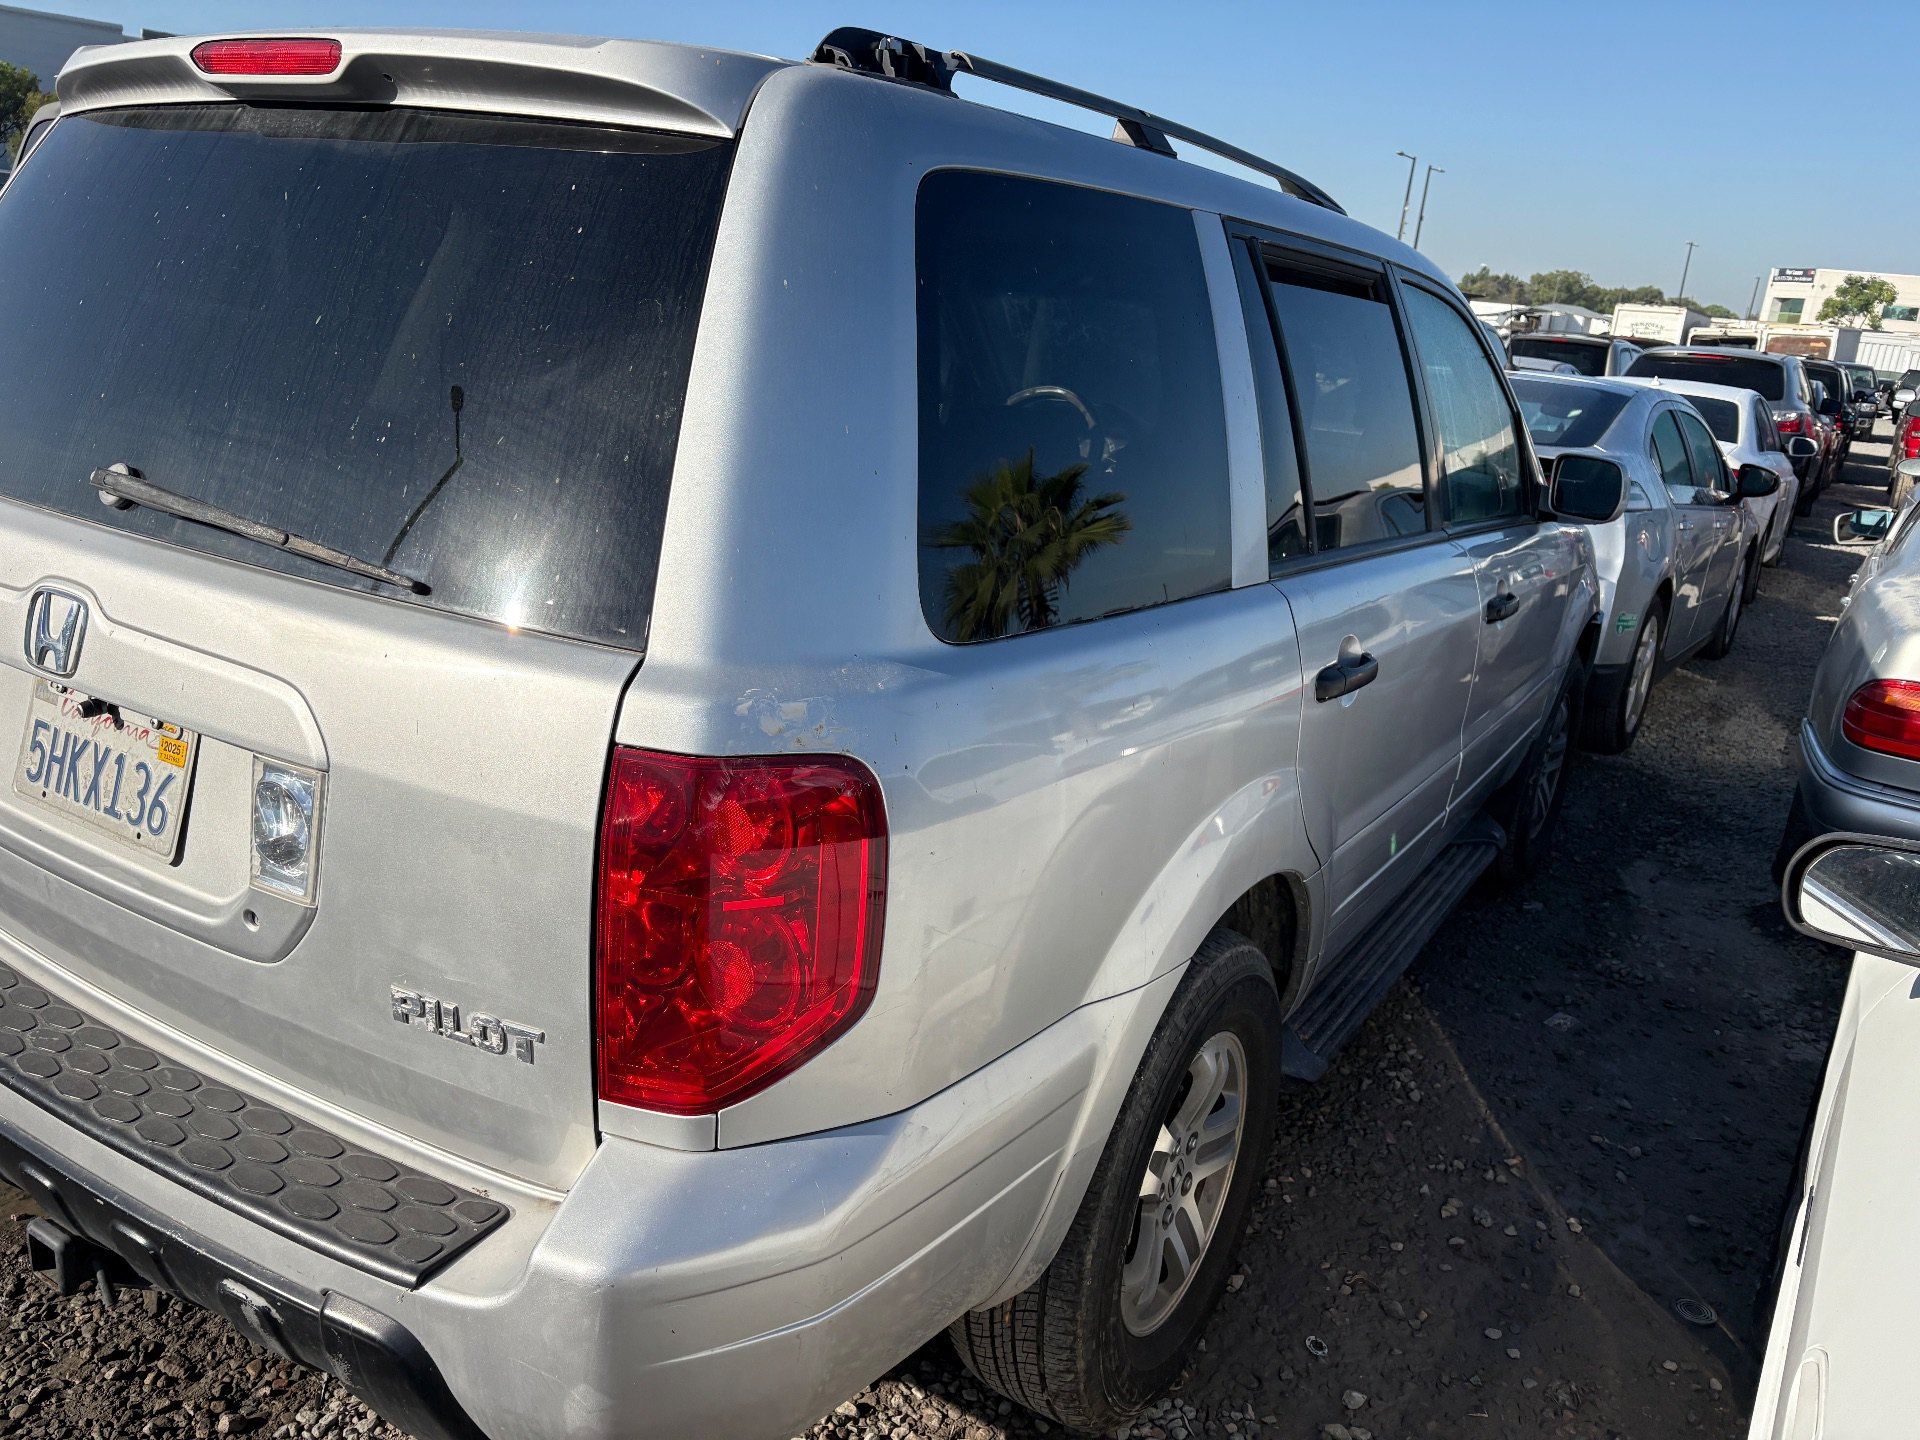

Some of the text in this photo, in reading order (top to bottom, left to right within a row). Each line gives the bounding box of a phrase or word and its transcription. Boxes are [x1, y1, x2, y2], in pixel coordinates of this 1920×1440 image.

[25, 718, 177, 836] 5HKX136
[163, 740, 182, 756] 2025
[390, 982, 546, 1065] PILOT
